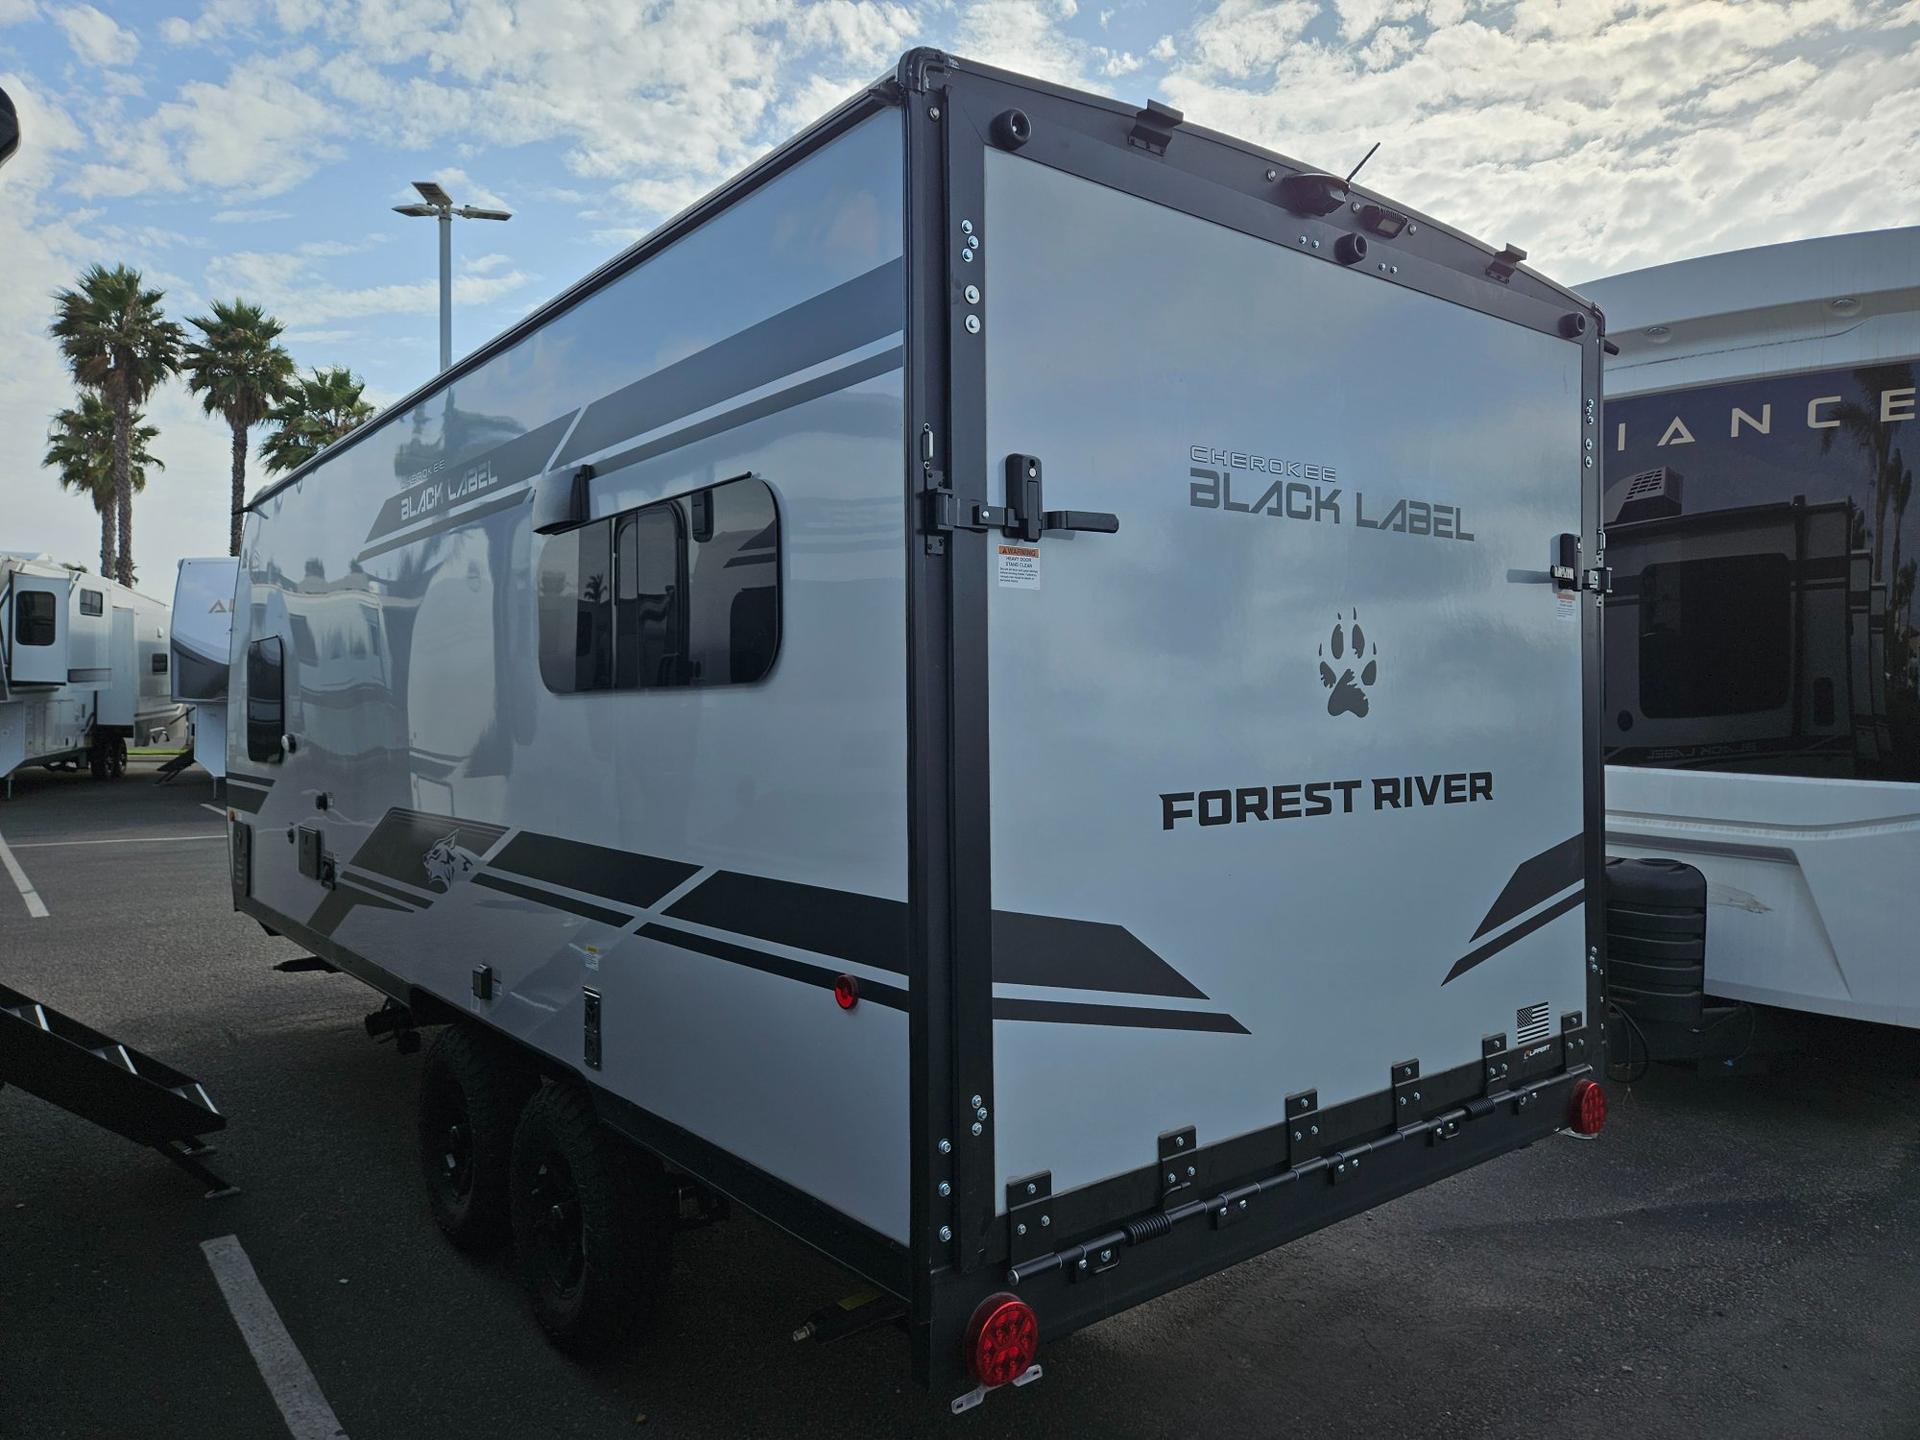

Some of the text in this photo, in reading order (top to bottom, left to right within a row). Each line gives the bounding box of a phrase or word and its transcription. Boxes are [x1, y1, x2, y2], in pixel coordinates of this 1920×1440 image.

[1617, 387, 1916, 452] IANCE
[400, 460, 499, 521] BLACK LABEL
[1190, 445, 1337, 483] CHEROKEE
[1190, 467, 1475, 542] BLACK LABEL
[1008, 547, 1036, 557] WARNING
[1158, 771, 1494, 831] FOREST RIVER
